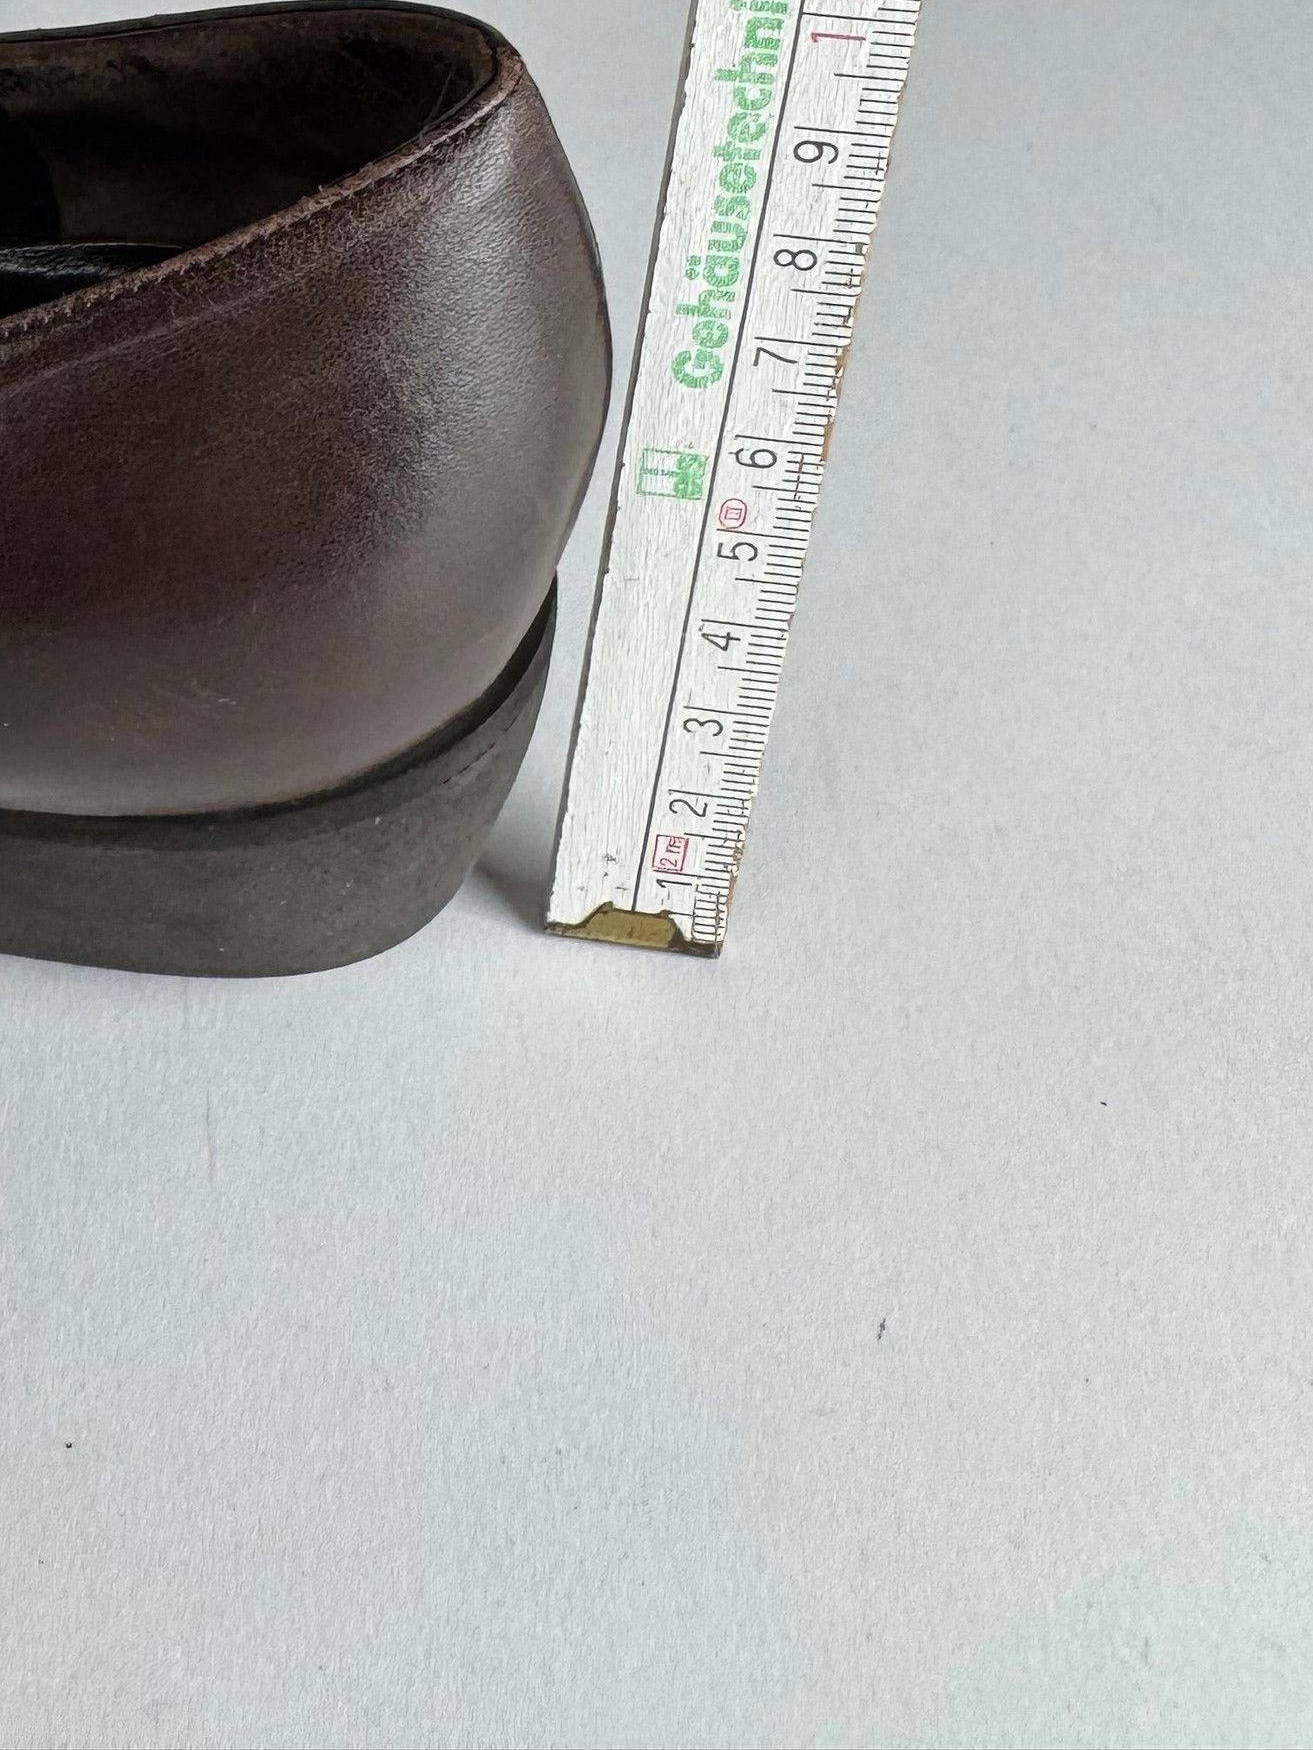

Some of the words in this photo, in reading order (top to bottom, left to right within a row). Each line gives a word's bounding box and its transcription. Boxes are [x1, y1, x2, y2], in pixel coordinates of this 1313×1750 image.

[793, 139, 839, 165] 9
[773, 248, 818, 272] 8
[753, 345, 798, 368] 7
[735, 447, 778, 470] 6
[716, 541, 759, 562] 5
[701, 630, 741, 651] 4
[683, 716, 724, 738] 3
[668, 797, 708, 819] 2
[655, 878, 693, 891] 1
